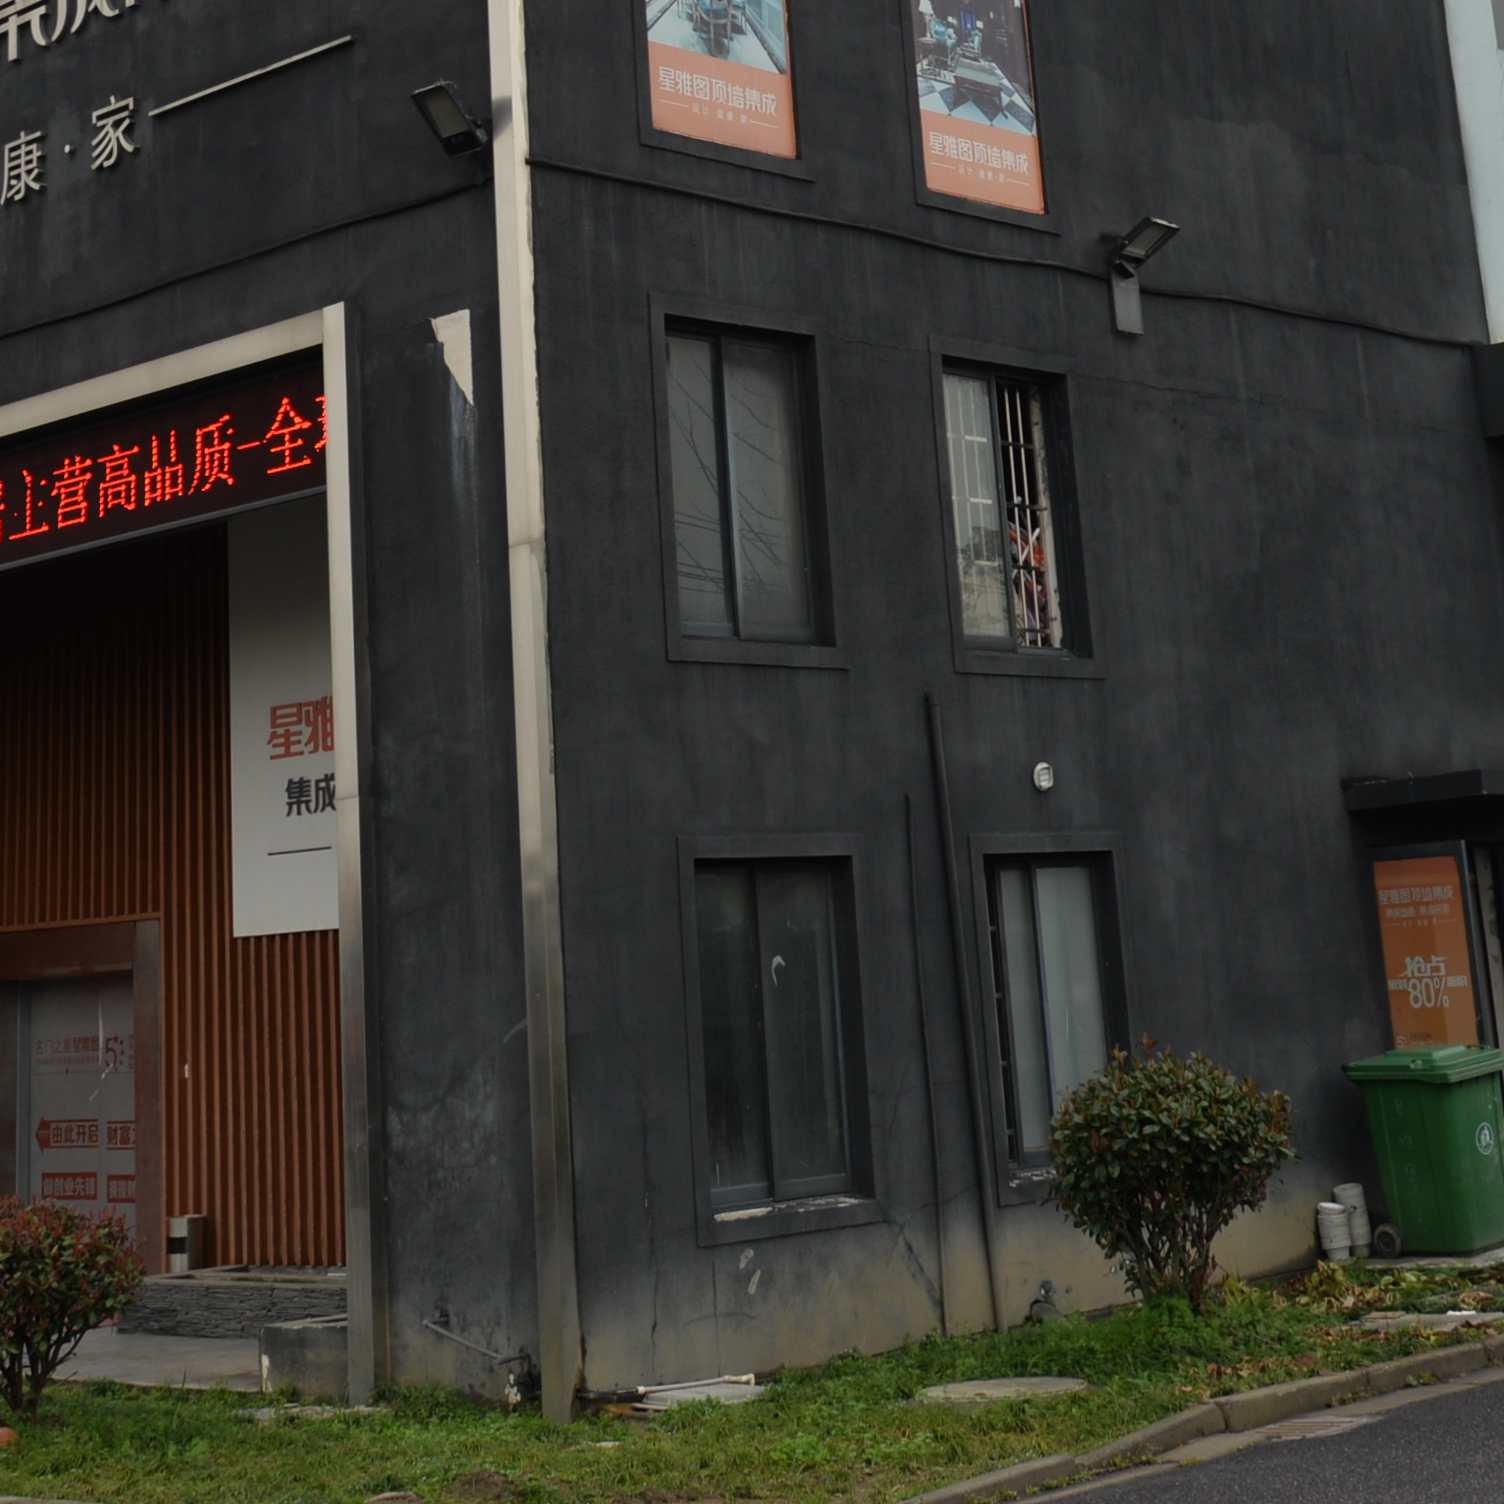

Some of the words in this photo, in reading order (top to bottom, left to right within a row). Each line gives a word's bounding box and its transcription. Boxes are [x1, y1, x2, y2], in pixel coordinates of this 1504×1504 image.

[658, 66, 778, 117] 星雅图顶墙集成
[929, 131, 1029, 176] 星雅图顶墙集成
[285, 773, 336, 817] 集成
[1398, 955, 1446, 977] 抢占
[1409, 977, 1449, 1009] 80%
[52, 1124, 99, 1144] 由此开启
[107, 1125, 136, 1145] 财富
